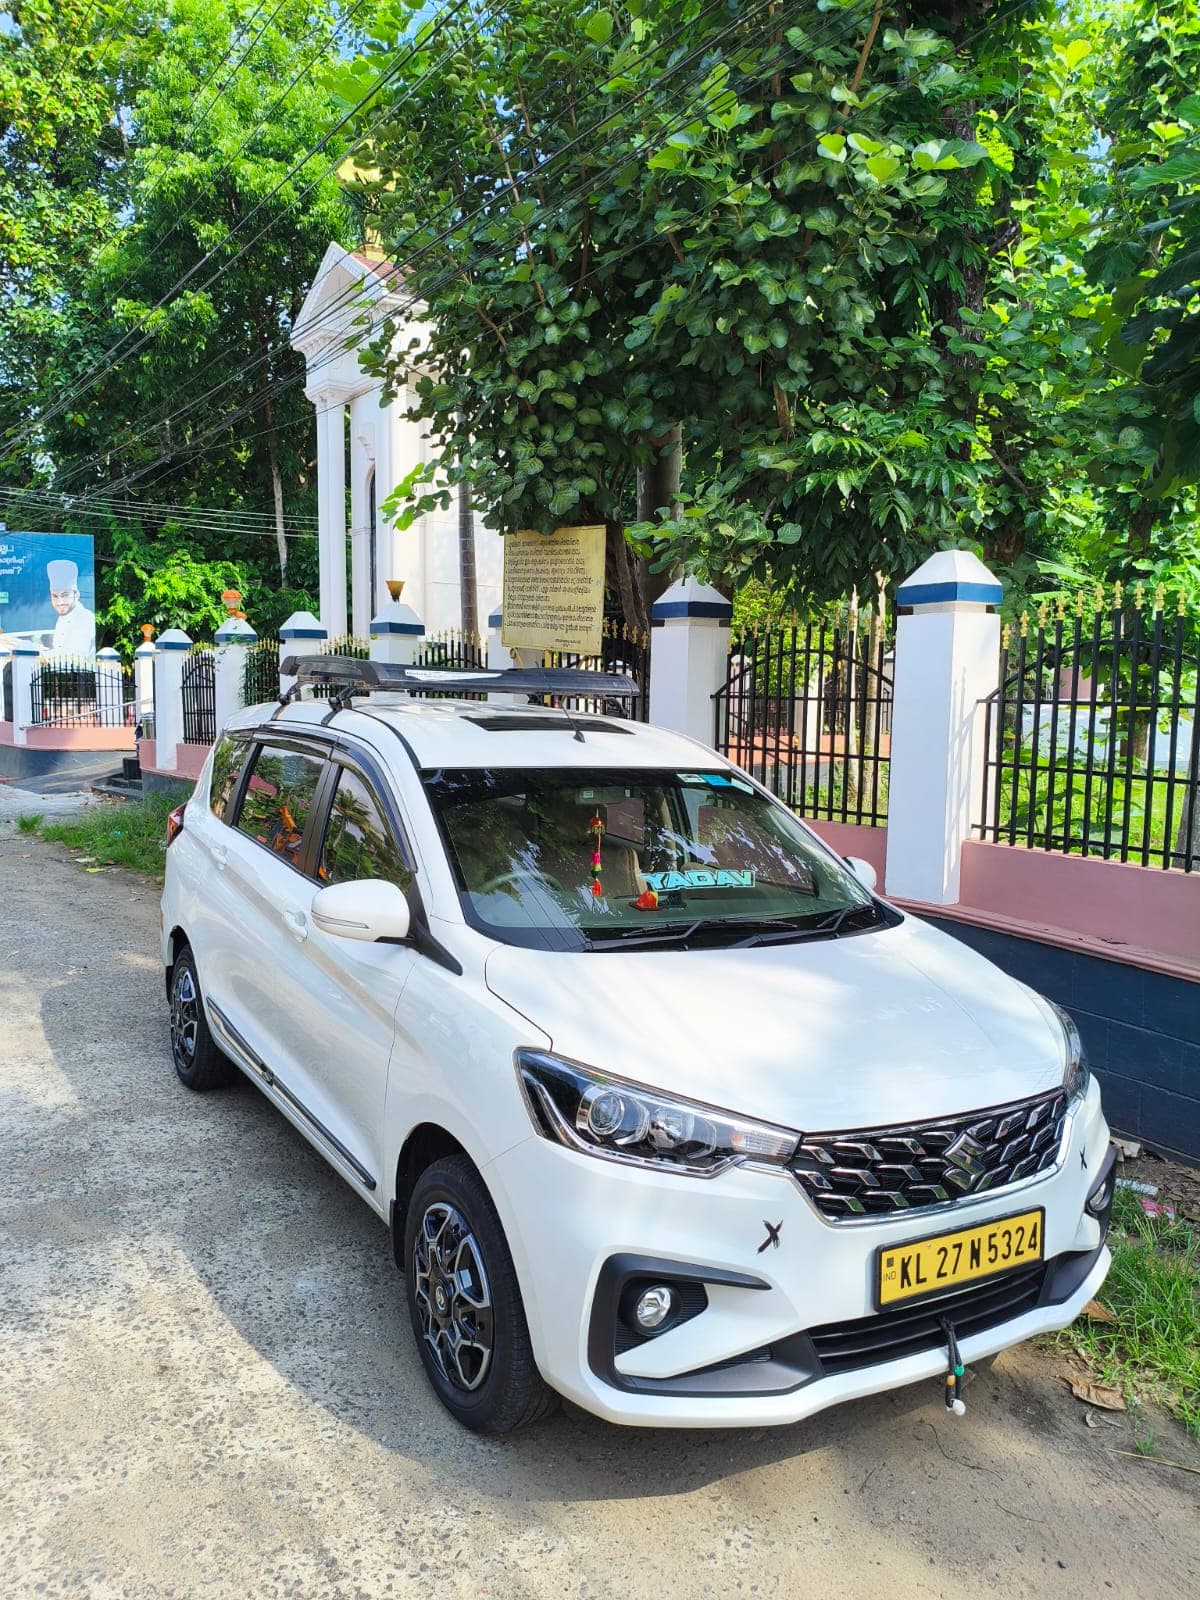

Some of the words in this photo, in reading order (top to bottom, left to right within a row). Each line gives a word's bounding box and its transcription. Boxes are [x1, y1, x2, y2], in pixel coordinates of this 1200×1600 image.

[637, 870, 755, 891] YADAV
[900, 1253, 927, 1289] KL
[936, 1242, 963, 1279] 27
[969, 1237, 982, 1270] N
[988, 1222, 1038, 1263] 5324
